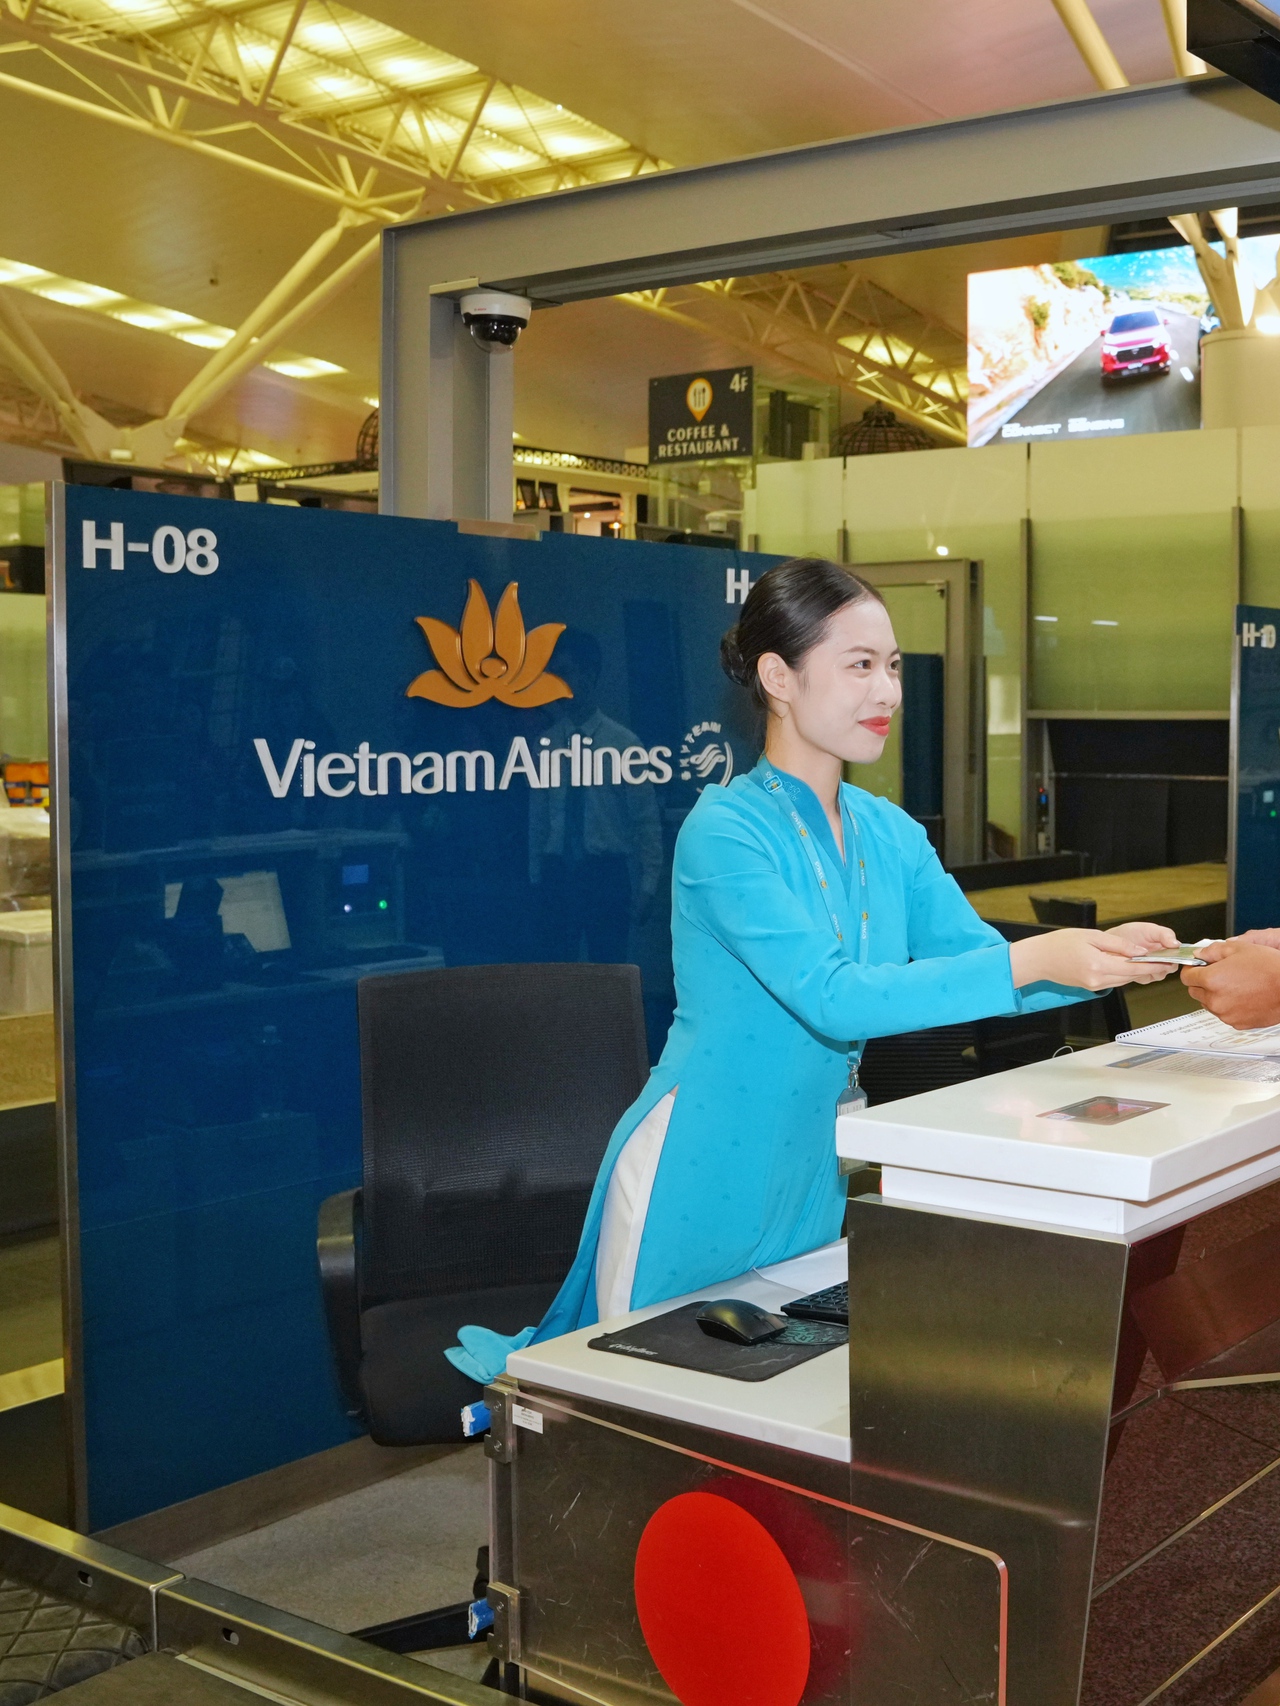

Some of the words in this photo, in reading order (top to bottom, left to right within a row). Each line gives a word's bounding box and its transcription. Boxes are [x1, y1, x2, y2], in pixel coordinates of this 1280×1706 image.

[729, 373, 749, 393] 4F
[667, 424, 716, 442] COFFEE
[720, 423, 730, 437] &
[658, 437, 739, 458] RESTAURANT
[82, 519, 220, 576] H-08
